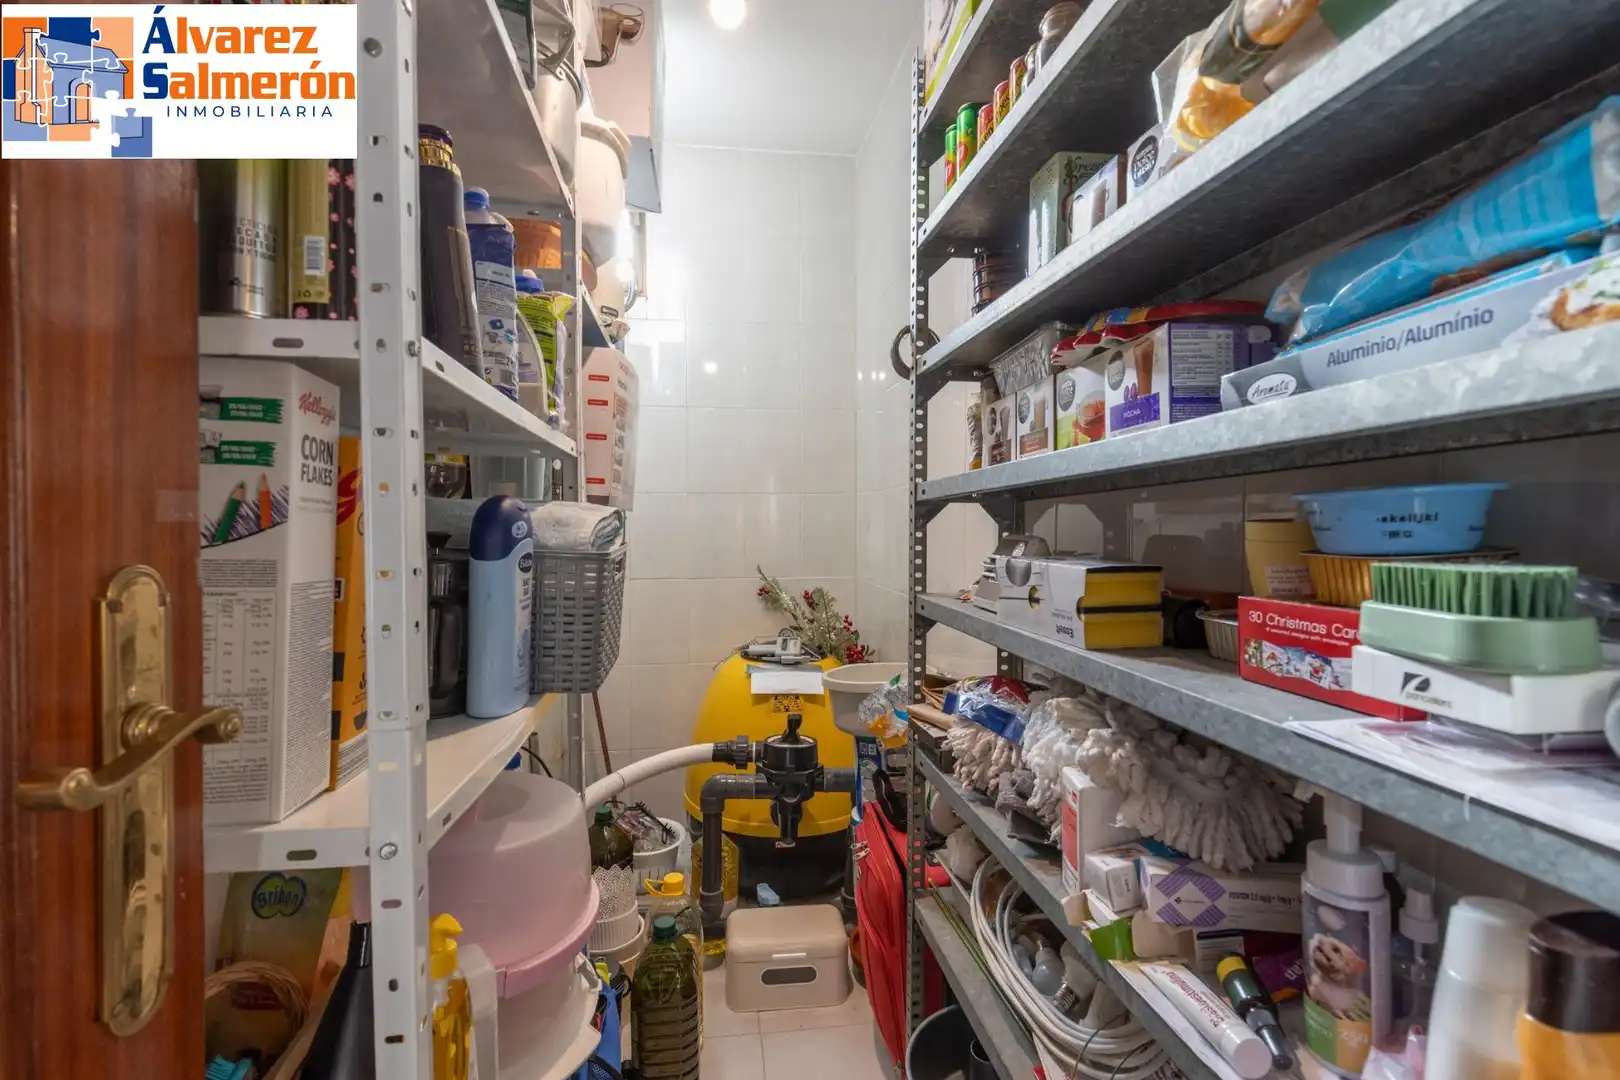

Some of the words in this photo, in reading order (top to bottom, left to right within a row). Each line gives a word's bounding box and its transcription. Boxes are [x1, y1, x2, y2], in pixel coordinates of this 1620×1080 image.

[1326, 307, 1495, 368] Aluminio/Alumínio
[301, 434, 335, 467] CORN
[301, 463, 334, 488] FLAKES
[1248, 610, 1263, 624] 30
[1266, 612, 1328, 635] Christmas
